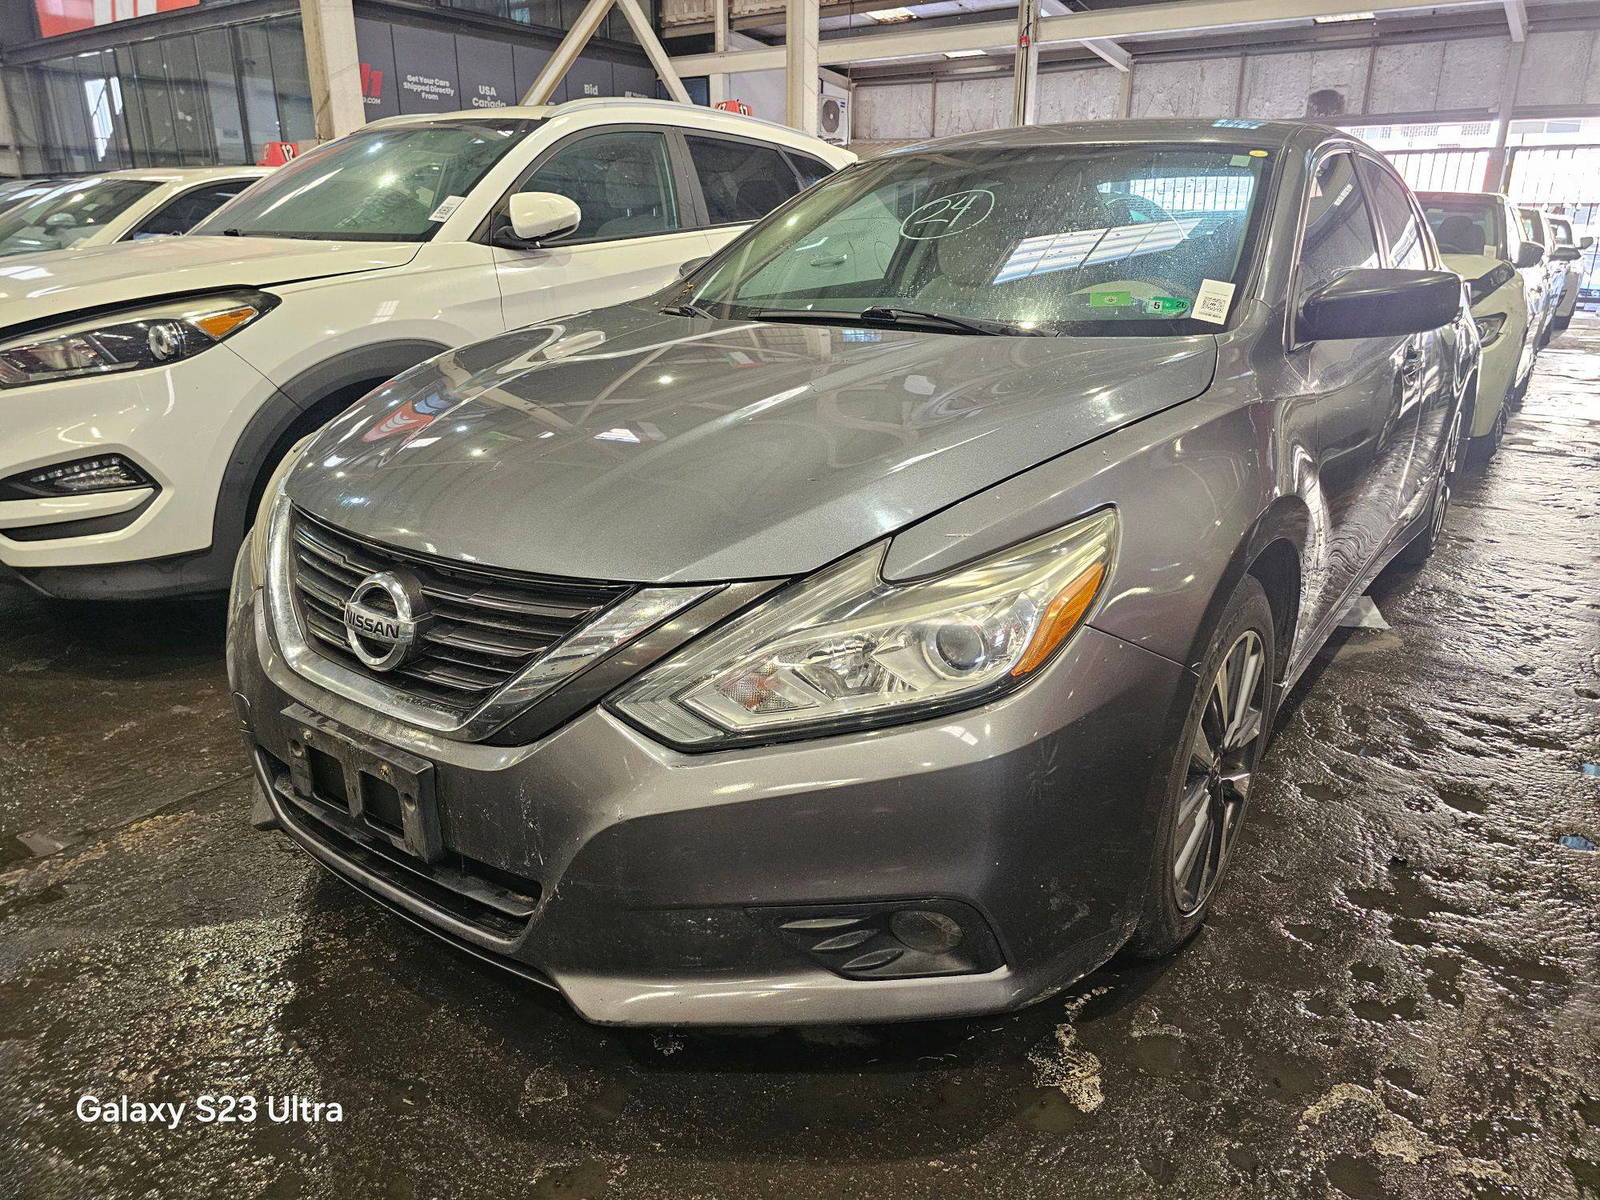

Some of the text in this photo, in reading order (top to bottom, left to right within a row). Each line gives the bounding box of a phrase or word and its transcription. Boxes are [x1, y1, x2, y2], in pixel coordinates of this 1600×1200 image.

[406, 74, 450, 87] Get Your Cars
[403, 81, 455, 97] Shipped Directly
[478, 84, 497, 97] USA
[583, 84, 599, 96] Bid
[421, 91, 439, 101] From
[471, 97, 507, 108] Canada
[913, 194, 978, 230] 24
[1153, 301, 1161, 310] 5
[345, 609, 400, 639] NISSAN
